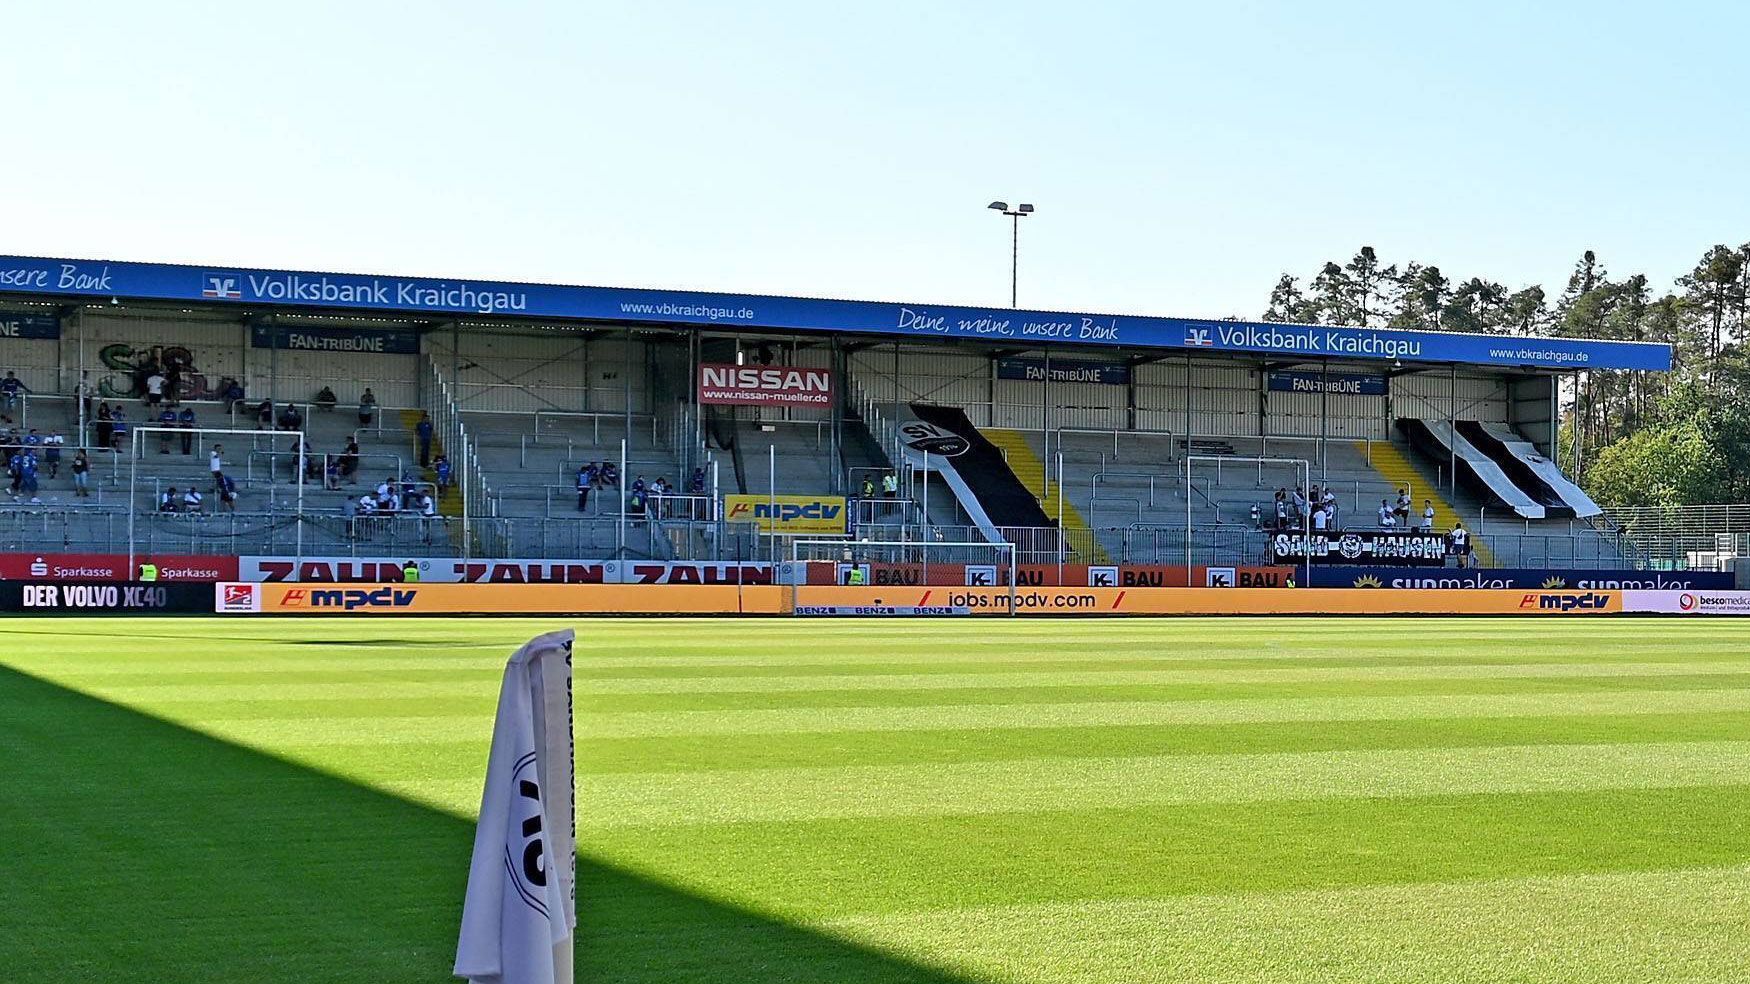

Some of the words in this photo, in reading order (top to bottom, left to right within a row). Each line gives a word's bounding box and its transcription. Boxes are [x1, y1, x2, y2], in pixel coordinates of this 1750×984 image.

[57, 264, 112, 290] Bank
[249, 274, 389, 304] Volksbank
[397, 282, 526, 313] Kraichgau
[620, 302, 754, 320] www.vbkraichgau.de
[897, 307, 950, 333] Deine,
[957, 315, 1015, 336] meine,
[1022, 321, 1073, 337] unsere
[1079, 317, 1118, 340] Bank
[288, 333, 384, 352] FAN-TRIBÜNE
[1218, 325, 1320, 350] Volksbank
[1326, 332, 1421, 359] Kraichgau
[1489, 348, 1589, 363] www.vbkraichgau.de
[702, 367, 829, 391] NISSAN
[1026, 366, 1101, 382] FAN-TRIBÜNE
[1292, 377, 1361, 393] FAN-TRIBÜNE
[703, 389, 828, 403] www.nissan-mueller.de
[902, 424, 942, 439] SV
[754, 502, 841, 522] mpdv
[1276, 534, 1329, 557] SAND
[1372, 537, 1442, 559] HAUSEN
[53, 566, 113, 578] Sparkasse
[161, 567, 218, 578] Sparkasse
[875, 569, 920, 585] BAU
[1124, 570, 1163, 587] BAU
[1240, 572, 1278, 587] BAU
[23, 585, 58, 607] DER
[63, 585, 117, 607] VOLVO
[123, 586, 167, 607] XC40
[311, 587, 418, 610] mpdv
[1539, 592, 1610, 611] mpdv
[796, 607, 828, 615] BENZ
[855, 607, 886, 615] BENZ
[913, 607, 944, 615] BENZ
